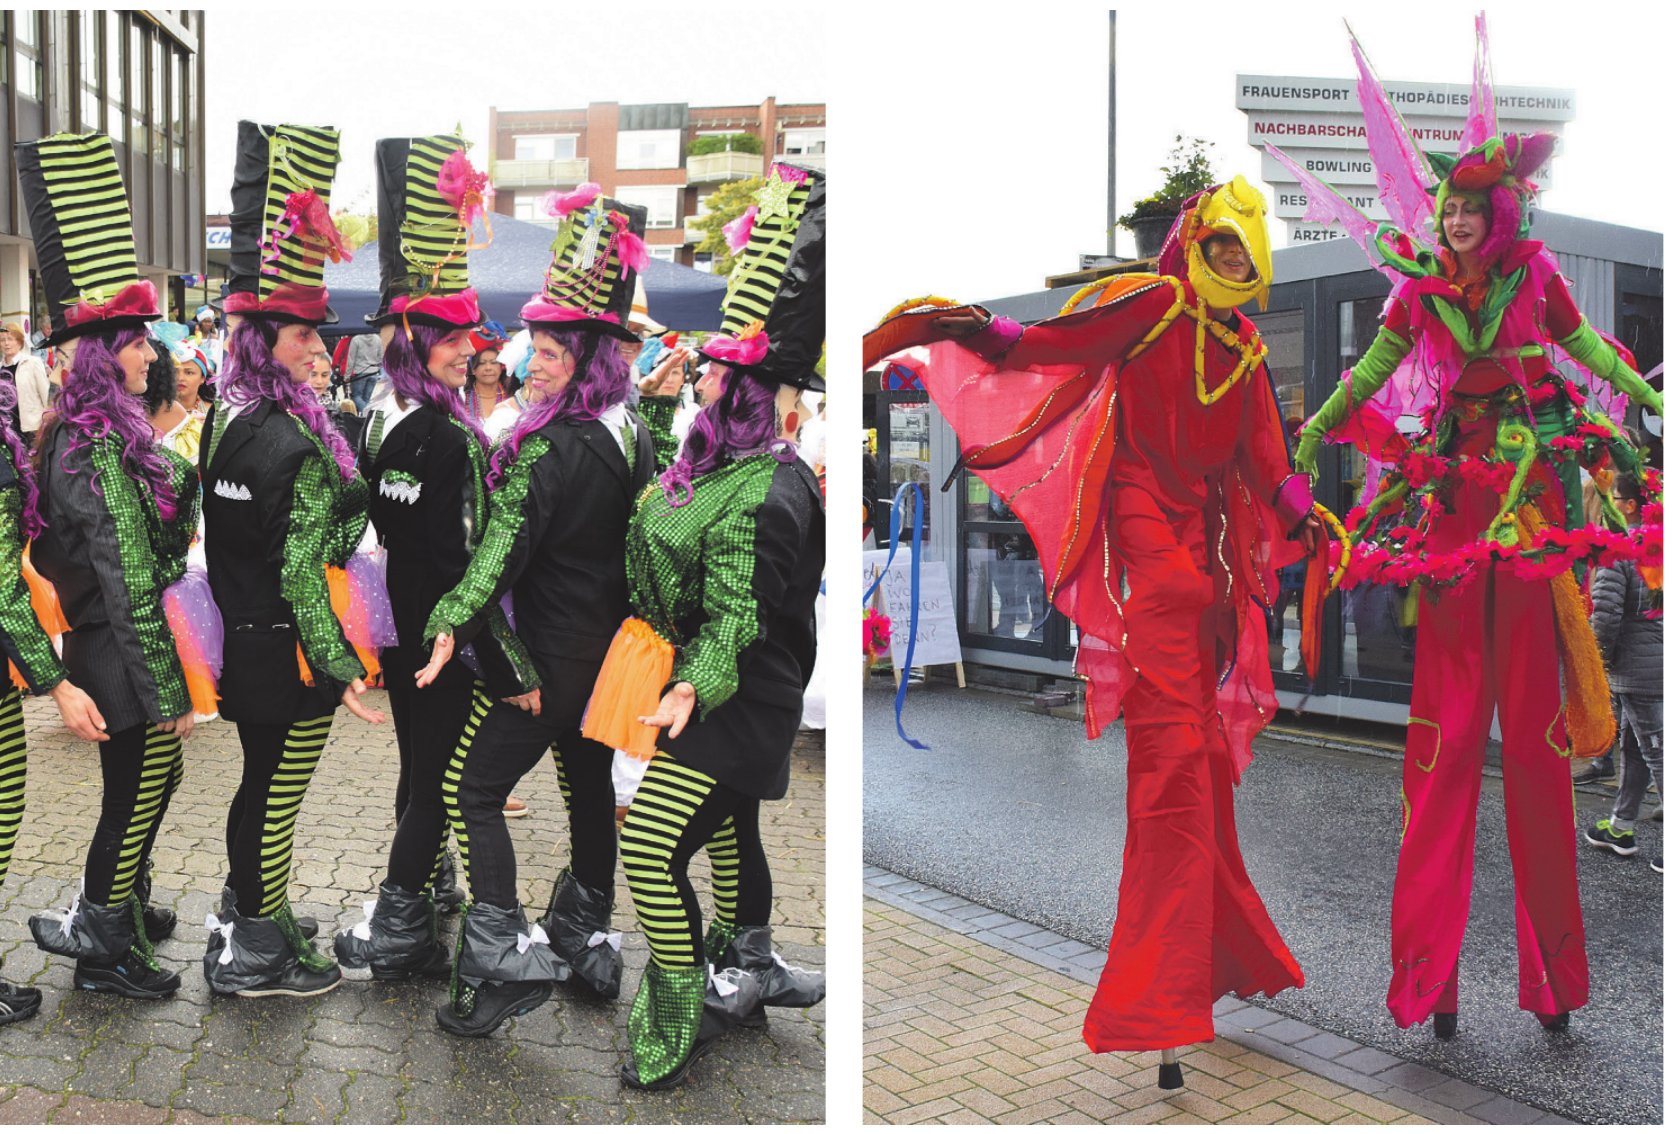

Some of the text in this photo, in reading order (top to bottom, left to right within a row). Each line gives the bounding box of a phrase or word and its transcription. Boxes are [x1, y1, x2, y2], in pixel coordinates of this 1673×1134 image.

[1242, 85, 1571, 110] FRAUENSPORT THOPÄDIESHTECHNIK
[1306, 160, 1372, 173] BOWLING
[1293, 227, 1337, 241] ÄRZTE
[887, 569, 907, 587] JA
